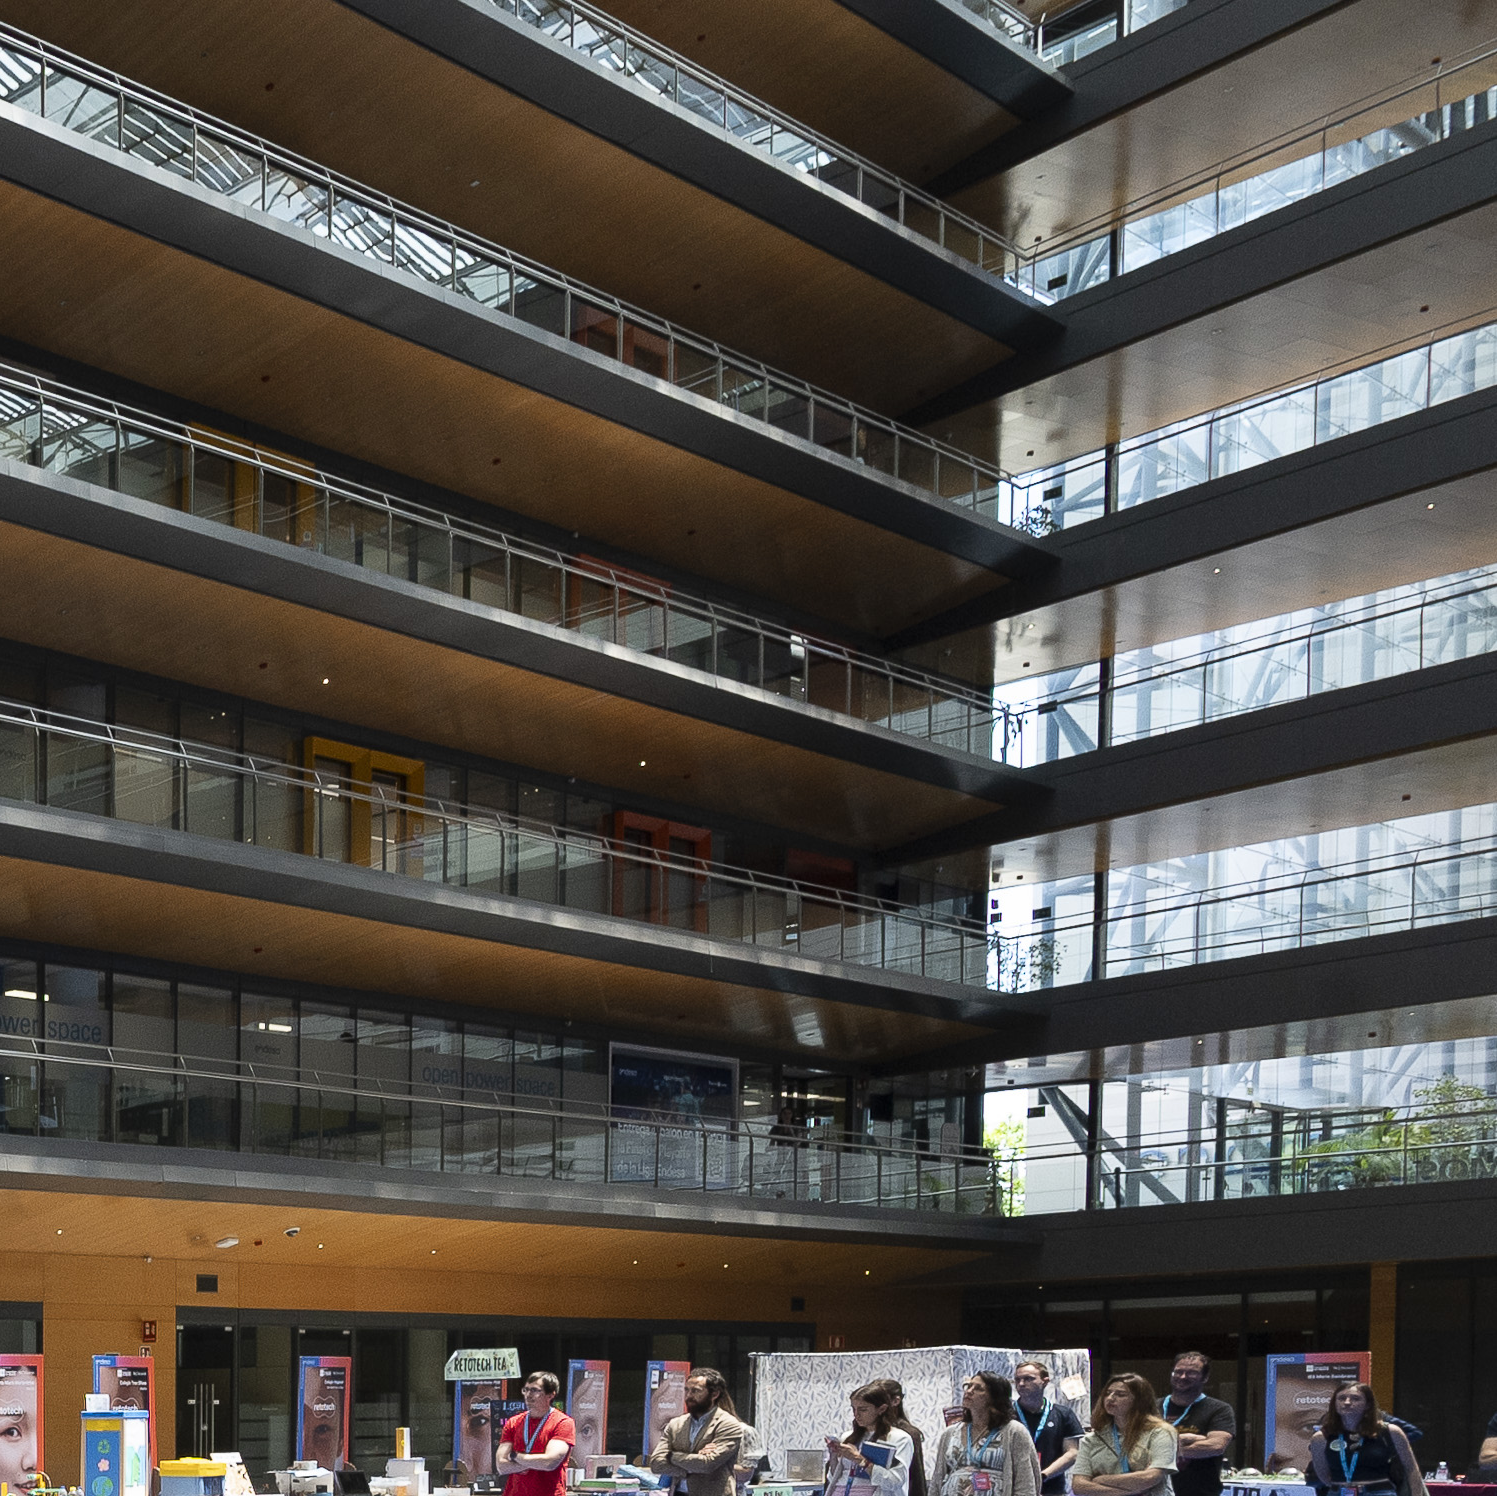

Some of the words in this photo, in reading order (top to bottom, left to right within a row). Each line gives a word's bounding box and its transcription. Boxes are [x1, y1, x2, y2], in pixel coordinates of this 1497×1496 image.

[48, 1018, 103, 1044] space
[422, 1065, 458, 1085] open
[466, 1069, 511, 1091] power
[516, 1076, 555, 1097] space
[454, 1357, 492, 1373] RETOTECH
